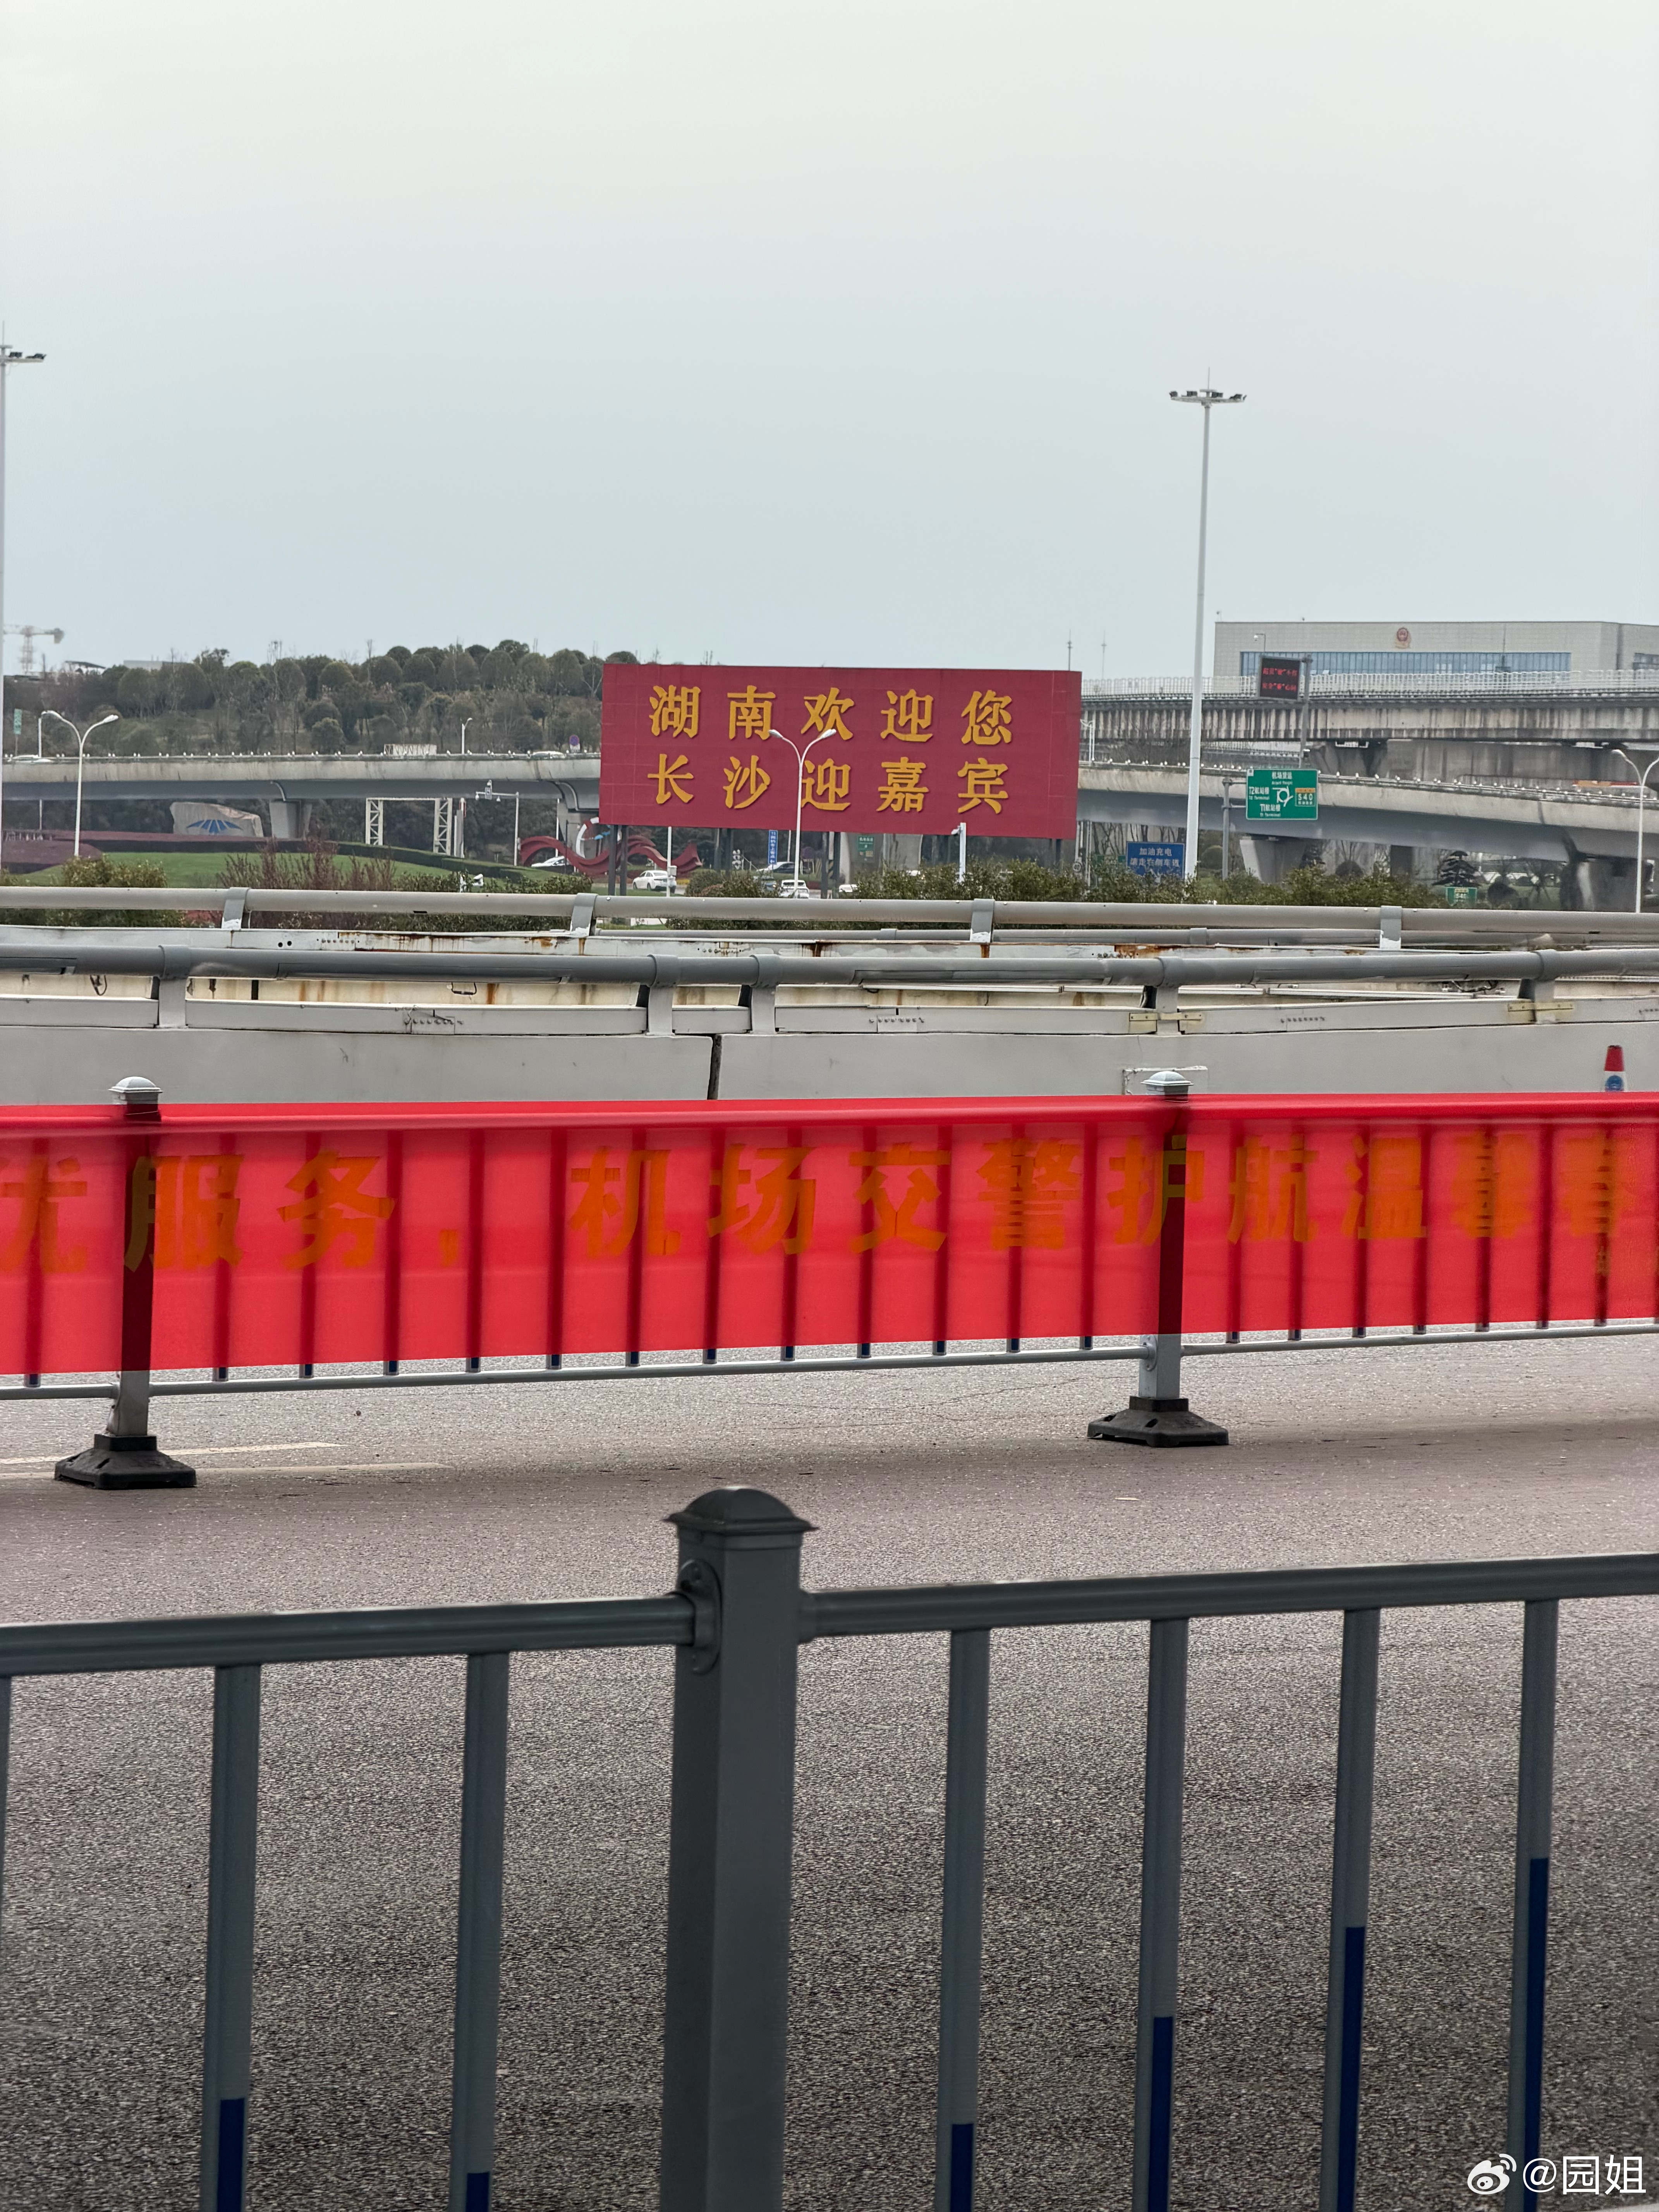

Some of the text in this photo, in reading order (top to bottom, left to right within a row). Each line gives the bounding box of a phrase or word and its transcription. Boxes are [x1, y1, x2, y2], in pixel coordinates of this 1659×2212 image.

[649, 685, 1012, 745] 湖南欢迎您
[647, 754, 1009, 814] 长沙迎嘉宾
[1139, 847, 1172, 856] 加油充电
